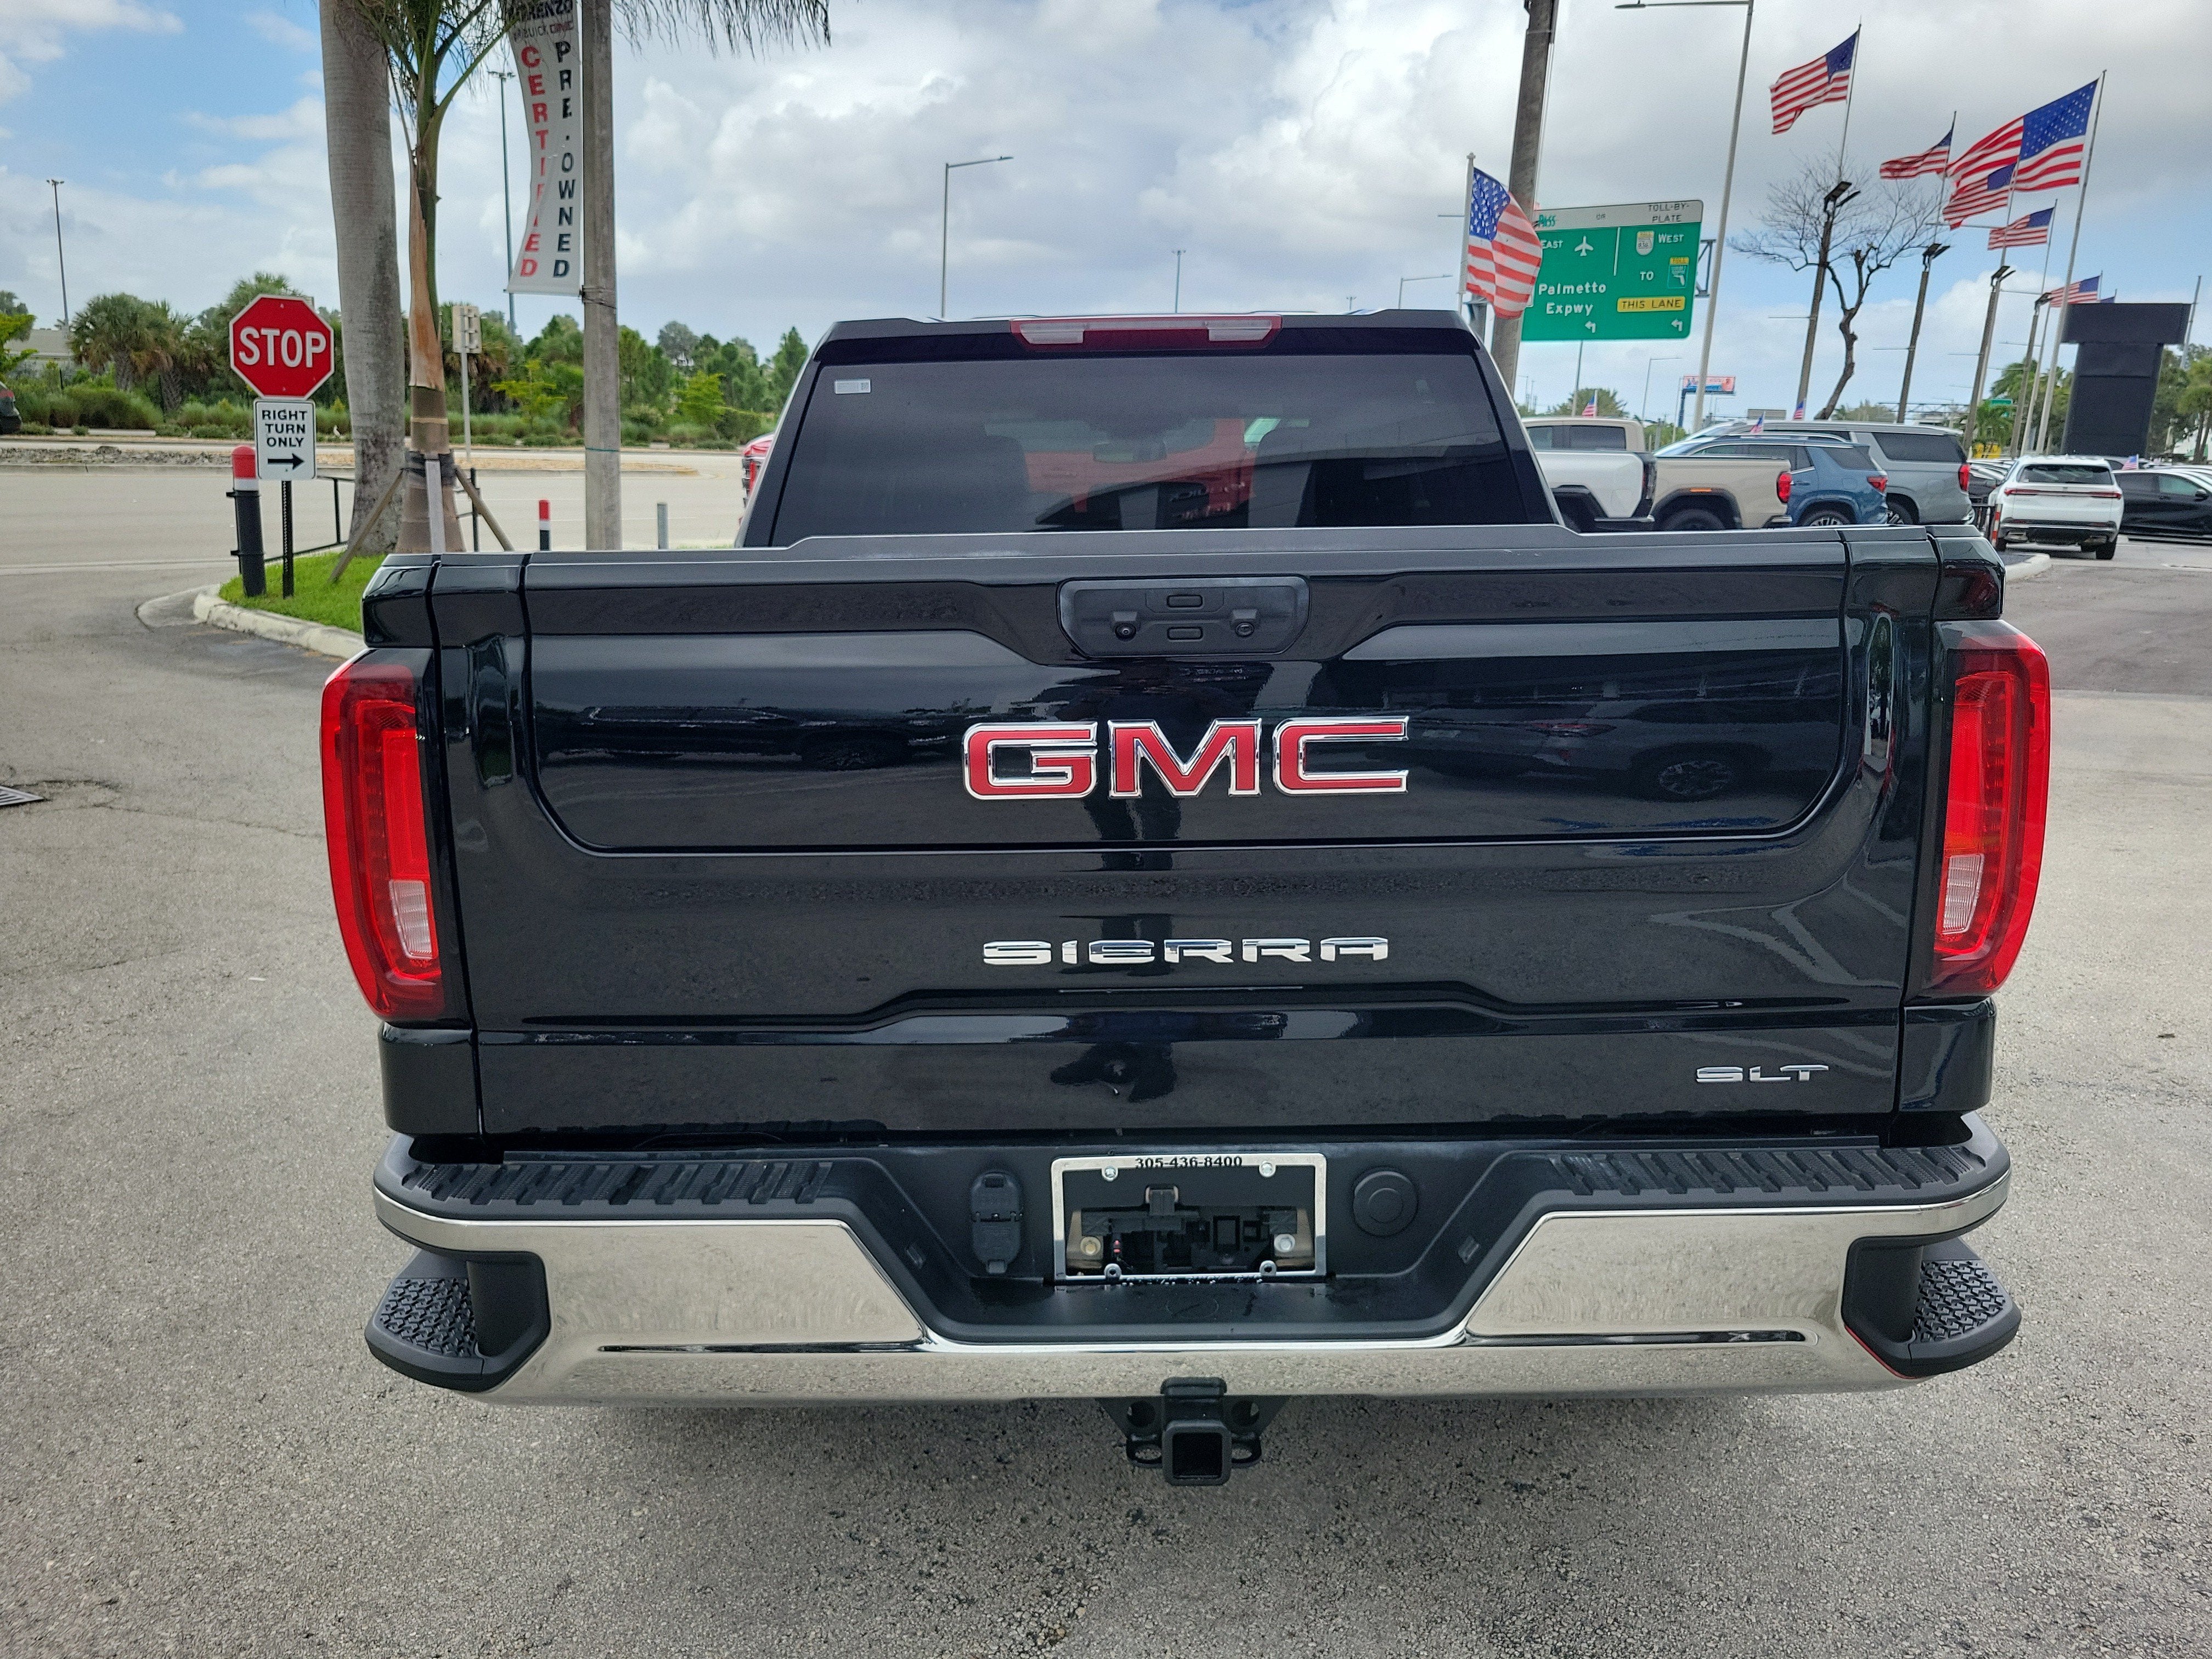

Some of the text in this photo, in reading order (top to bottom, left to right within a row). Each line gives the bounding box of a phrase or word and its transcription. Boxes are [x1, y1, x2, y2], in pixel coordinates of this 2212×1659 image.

[1652, 215, 1682, 223] PLATE
[1541, 239, 1563, 249] EAST
[1658, 233, 1684, 243] WEST
[1640, 270, 1654, 281] TO
[1538, 281, 1606, 295] Palmetto
[1546, 302, 1593, 316] Expwy
[1622, 300, 1681, 309] THIS LANE
[239, 326, 326, 368] STOP
[262, 409, 308, 421] RIGHT
[265, 423, 306, 434] TURN
[267, 437, 304, 447] ONLY
[962, 716, 1410, 800] GMC
[983, 936, 1389, 965] SIERRA
[1696, 1064, 1829, 1082] SLT
[1135, 1156, 1243, 1169] 305-436-8400
